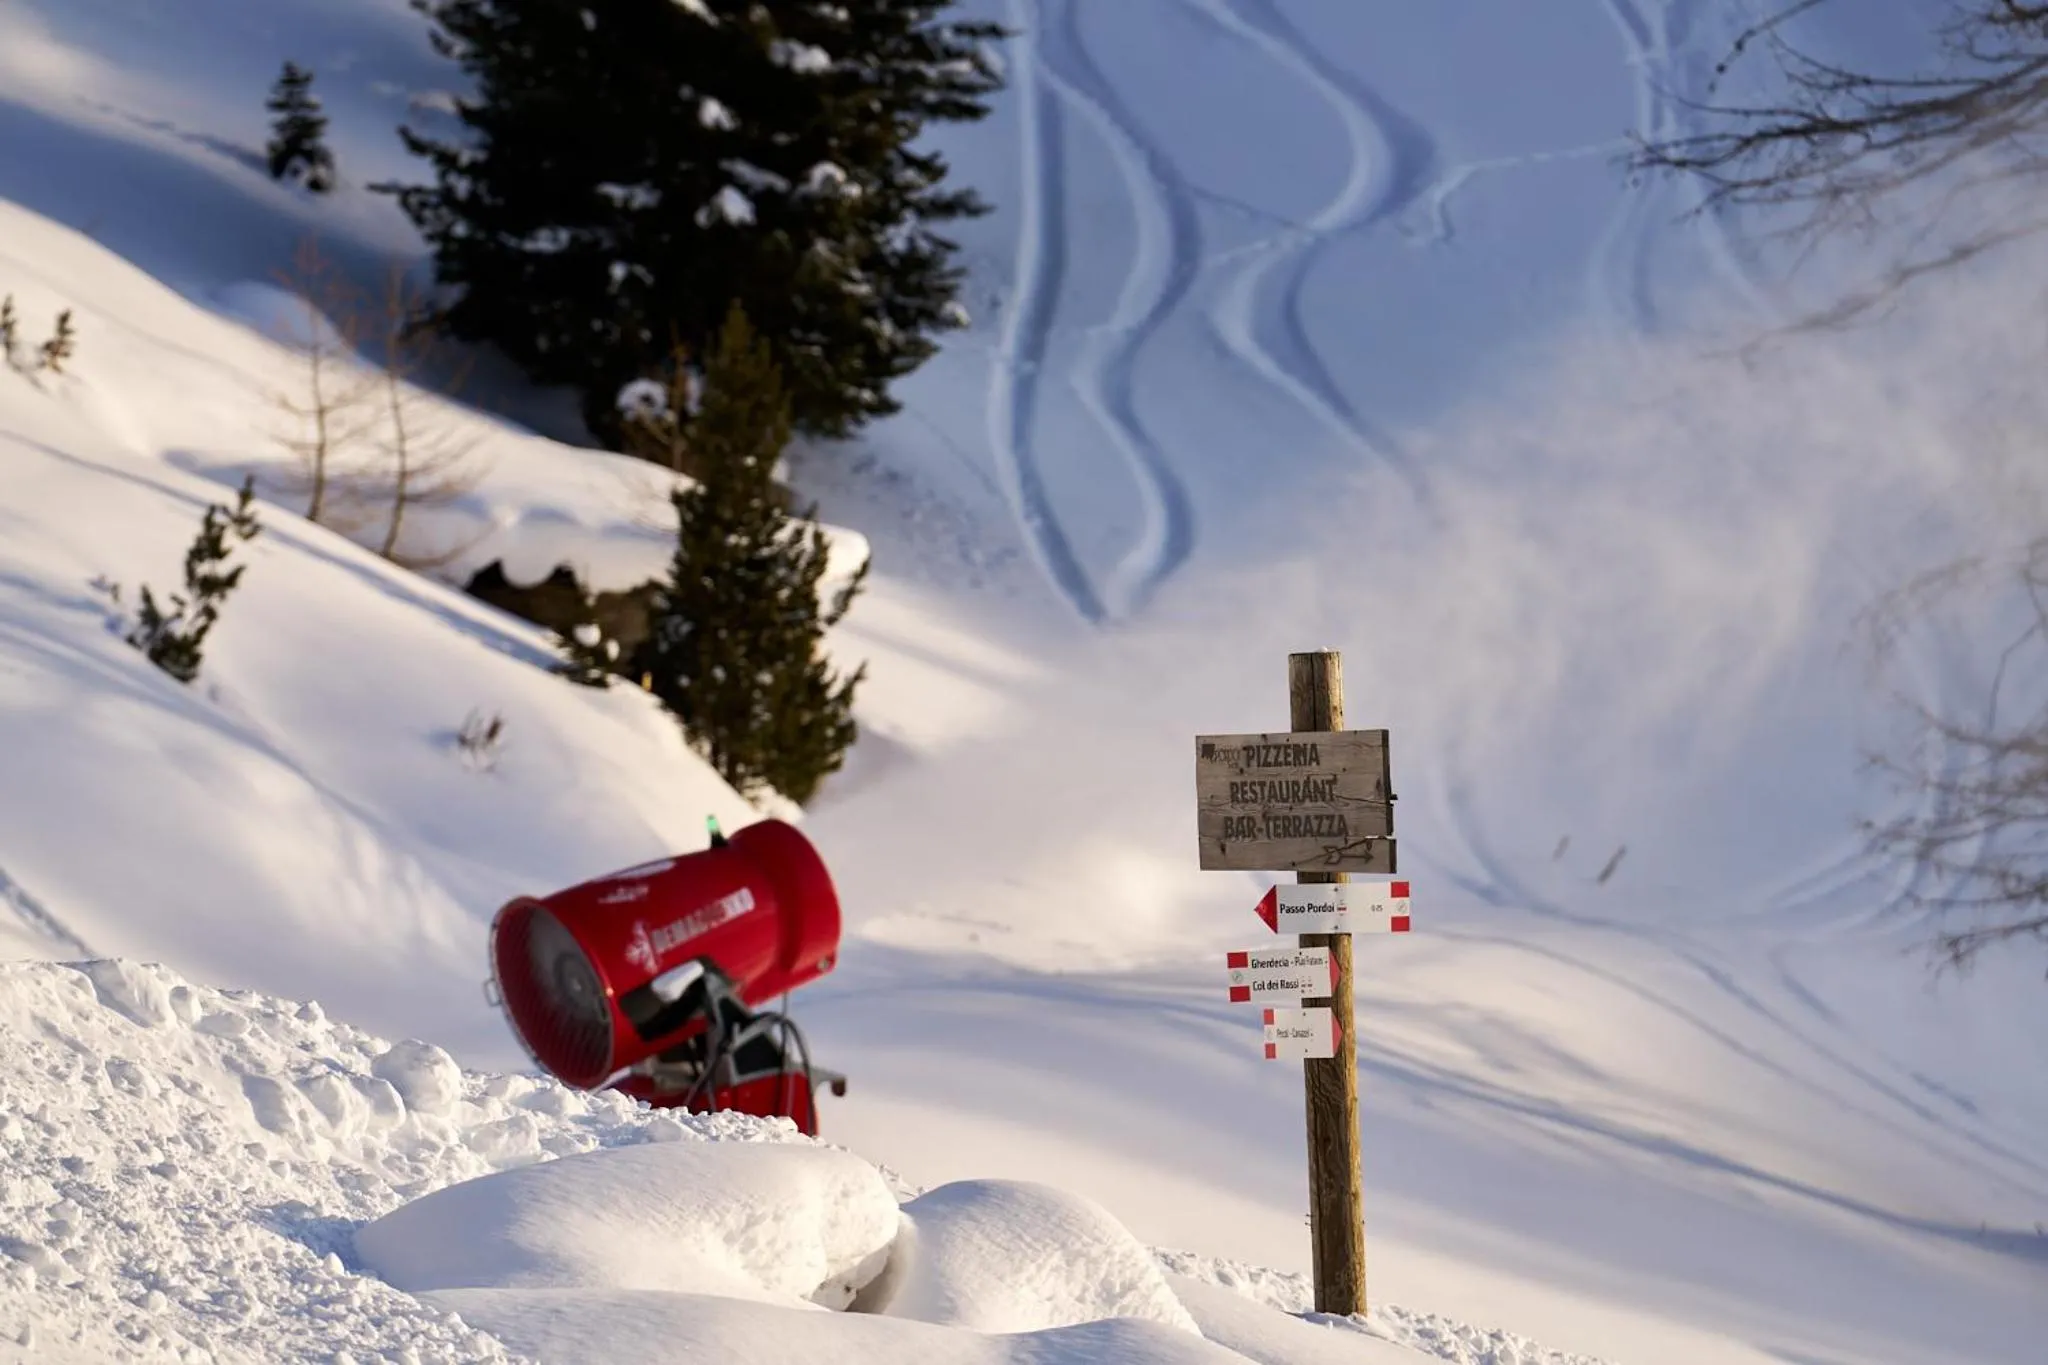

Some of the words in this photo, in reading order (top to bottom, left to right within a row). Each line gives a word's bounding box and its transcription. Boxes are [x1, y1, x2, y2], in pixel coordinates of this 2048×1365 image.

[1244, 743, 1320, 767] PIZZERIA
[1230, 779, 1336, 804] RESTAURANT
[1223, 814, 1349, 839] BAR-TERRAZZA
[1280, 903, 1305, 914] Passo
[1307, 902, 1335, 913] Pordoi
[1252, 980, 1265, 991] Col
[1266, 980, 1279, 990] dei
